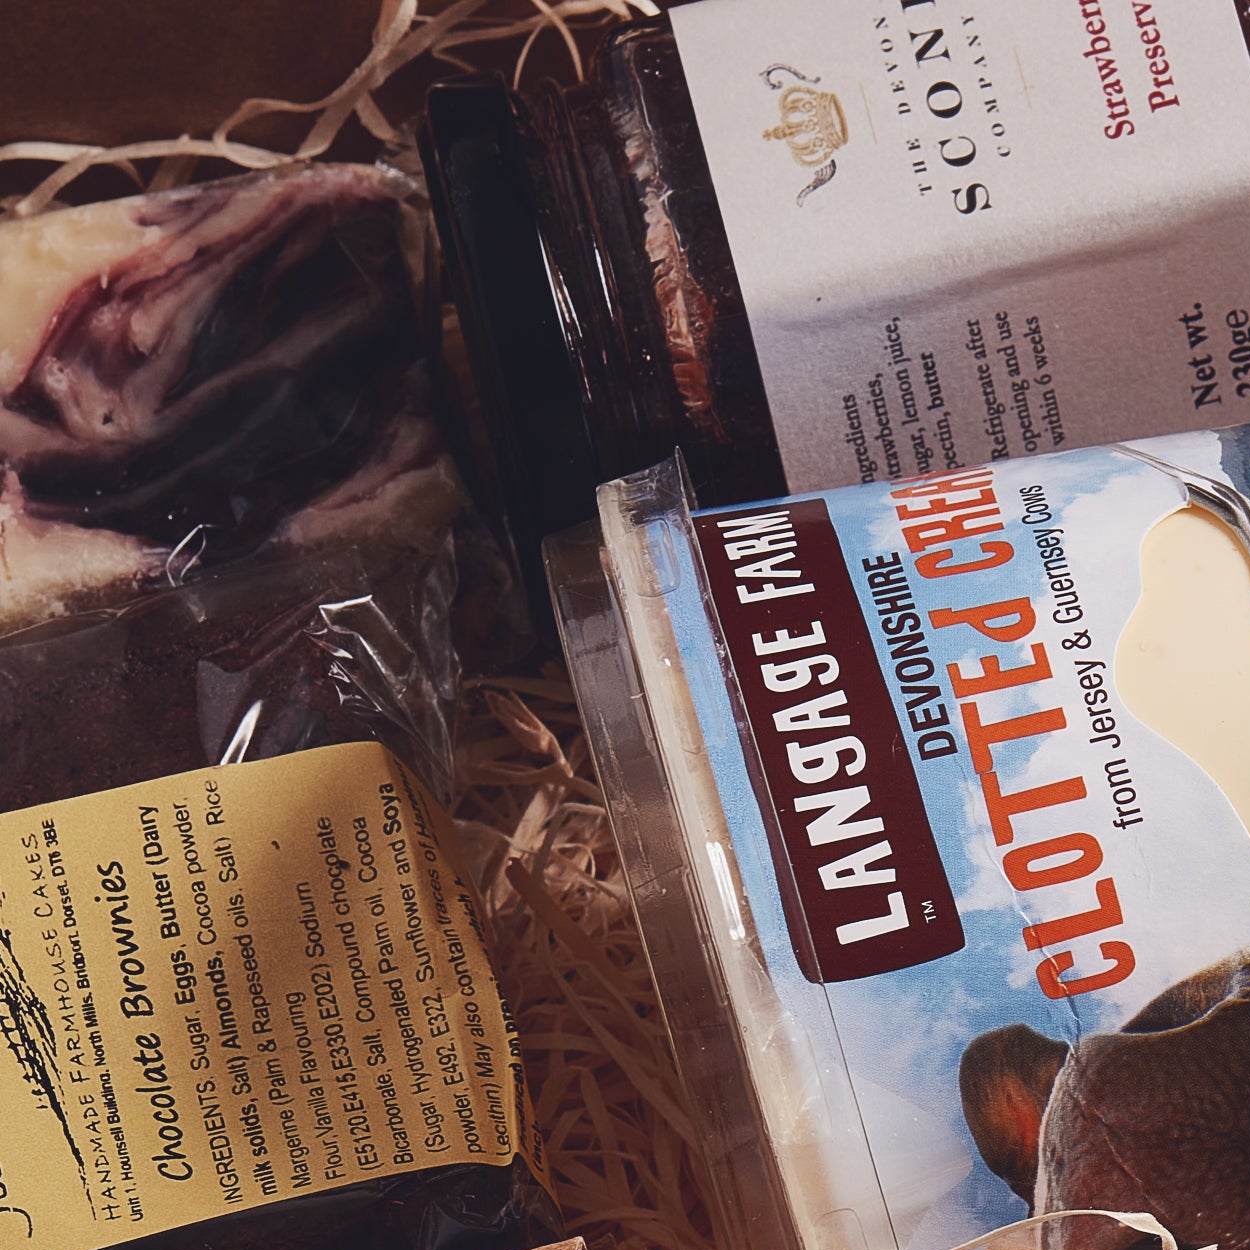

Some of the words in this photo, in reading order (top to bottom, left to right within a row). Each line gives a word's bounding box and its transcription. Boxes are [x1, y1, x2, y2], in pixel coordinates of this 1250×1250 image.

[873, 16, 912, 116] DEVON
[1079, 0, 1135, 139] Strawberr
[1132, 0, 1180, 113] Preserv
[961, 15, 1011, 158] COMPANY
[905, 138, 933, 196] THE
[884, 316, 912, 366] juice,
[966, 320, 987, 360] after
[996, 312, 1012, 341] use
[1023, 316, 1048, 370] weeks
[1178, 303, 1208, 349] wt.
[921, 352, 945, 411] butter
[996, 344, 1020, 377] and
[1034, 374, 1052, 385] 6
[1188, 354, 1222, 410] Net
[866, 373, 902, 480] trawberries,
[896, 368, 920, 426] lemon
[977, 363, 1010, 461] Refrigerate
[1010, 379, 1042, 452] opening
[1039, 388, 1065, 446] within
[842, 394, 878, 484] ngredients
[933, 412, 966, 470] pectin,
[1020, 486, 1052, 524] Cows
[717, 510, 815, 604] FARM
[1033, 529, 1083, 624] Guernsey
[862, 552, 958, 760] DEVONSHIRE
[1062, 629, 1091, 650] &
[1074, 661, 1120, 748] Jersey
[206, 781, 225, 825] Rice
[379, 784, 407, 835] Soya
[1105, 759, 1143, 830] from
[138, 806, 169, 865] (Dairy
[214, 837, 238, 882] Salt)
[352, 817, 377, 882] Cocoa
[387, 839, 411, 875] and
[21, 834, 53, 917] CAKES
[364, 888, 385, 916] oil,
[152, 872, 180, 939] Butter
[191, 880, 216, 945] Cocoa
[296, 882, 325, 958] Sodium
[400, 883, 434, 982] Sunflower
[95, 862, 154, 1019] Brownies
[374, 922, 399, 974] Palm
[446, 929, 475, 997] contain
[171, 944, 197, 1004] Eggs,
[205, 951, 242, 1049] Almonds,
[240, 934, 273, 1034] Rapeseed
[339, 922, 375, 1022] Compound
[42, 924, 90, 1083] FARMHOUSE
[464, 1002, 485, 1038] also
[88, 1031, 106, 1066] North
[185, 1011, 210, 1070] Sugar,
[257, 1038, 277, 1052] &
[286, 992, 321, 1084] Flavouring
[362, 1029, 387, 1066] Salt,
[383, 978, 432, 1094] Hydrogenated
[436, 1038, 464, 1086] E492,
[473, 1042, 495, 1077] May
[226, 1056, 252, 1095] Salt)
[265, 1058, 295, 1105] (Palm
[133, 1033, 193, 1180] Chocolate
[239, 1098, 268, 1156] solids,
[376, 1069, 414, 1164] Bicarbonate,
[420, 1096, 451, 1152] (Sugar,
[453, 1088, 488, 1153] powder,
[480, 1083, 512, 1156] Lecithin)
[78, 1094, 122, 1220] HANDMADE
[253, 1161, 278, 1195] milk
[280, 1110, 312, 1188] Margerine
[128, 1197, 143, 1221] Unit
